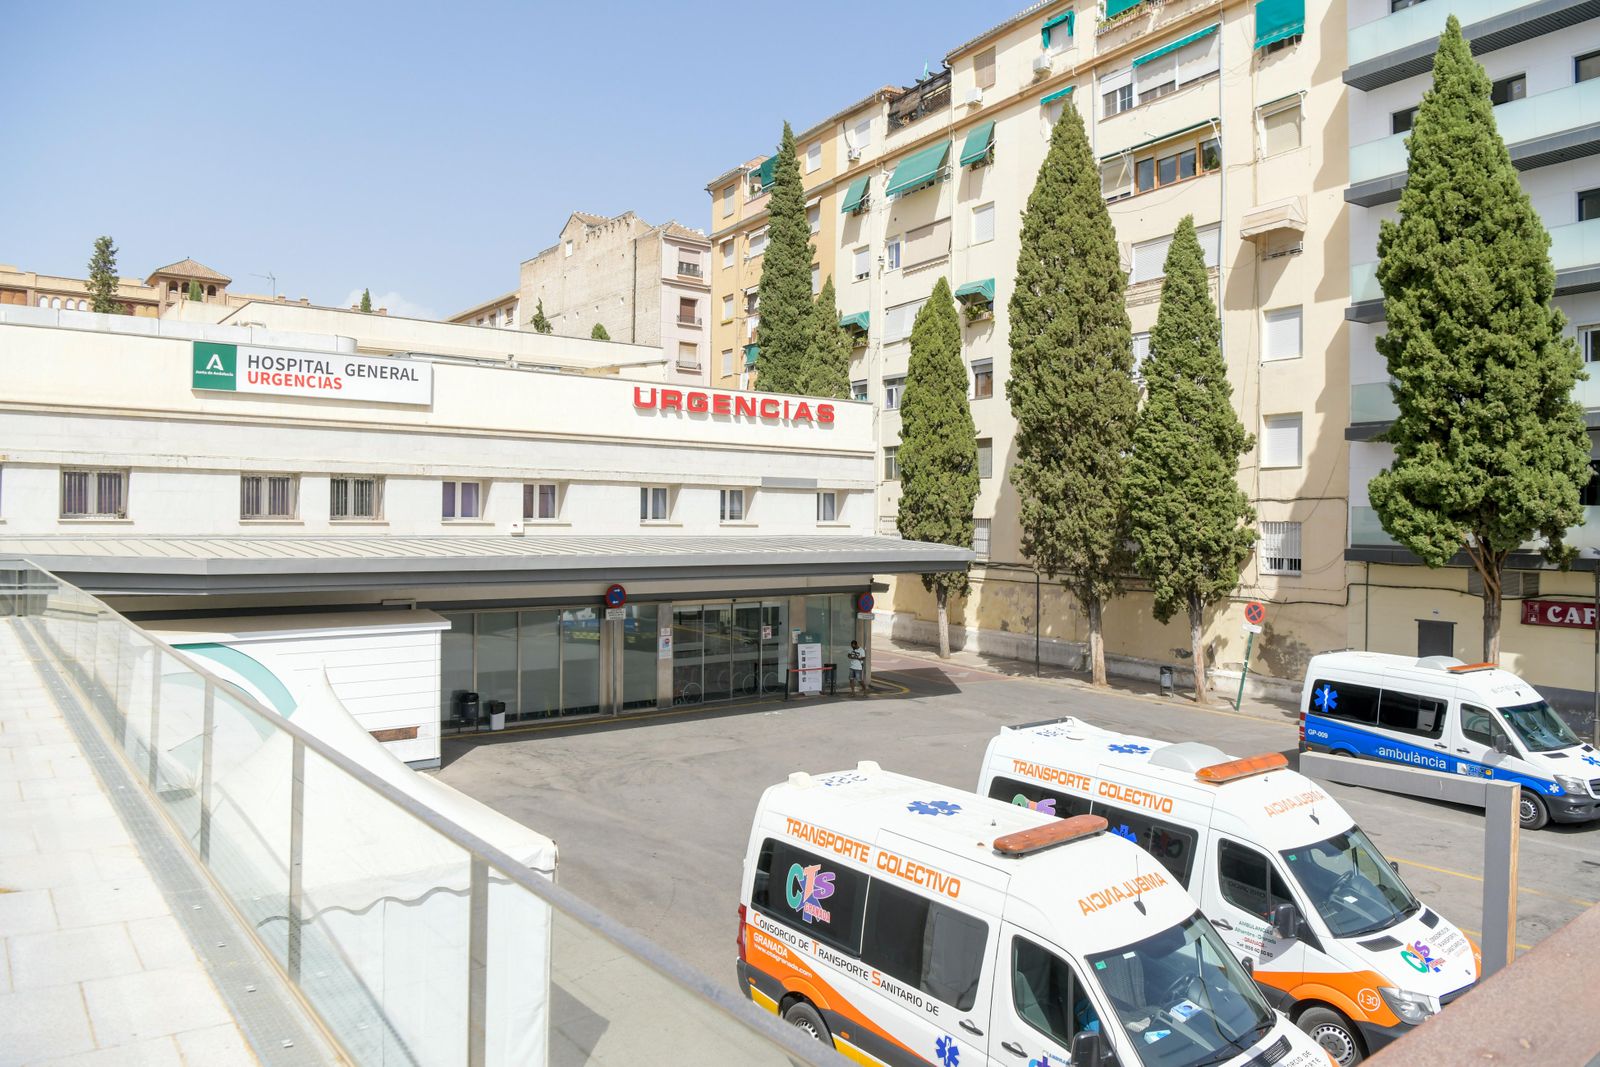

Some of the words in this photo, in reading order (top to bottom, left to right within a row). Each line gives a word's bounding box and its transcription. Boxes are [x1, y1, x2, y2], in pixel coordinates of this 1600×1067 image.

[247, 371, 343, 390] URGENCIAS
[248, 354, 334, 376] HOSPITAL
[345, 362, 419, 382] GENERAL
[633, 386, 835, 424] URGENCIAS
[1378, 746, 1447, 769] ambulància
[1013, 759, 1091, 791] TRANSPORTE
[1098, 781, 1174, 814] COLECTIVO
[786, 816, 871, 864] TRANSPORTE
[876, 851, 962, 899] COLECTIVO
[753, 932, 788, 959] GRANADA
[754, 913, 797, 945] CONSORCIO
[798, 939, 809, 951] DE
[812, 940, 869, 981] TRANSPORTE
[871, 970, 923, 1008] SANITARIO
[926, 1001, 939, 1017] DE
